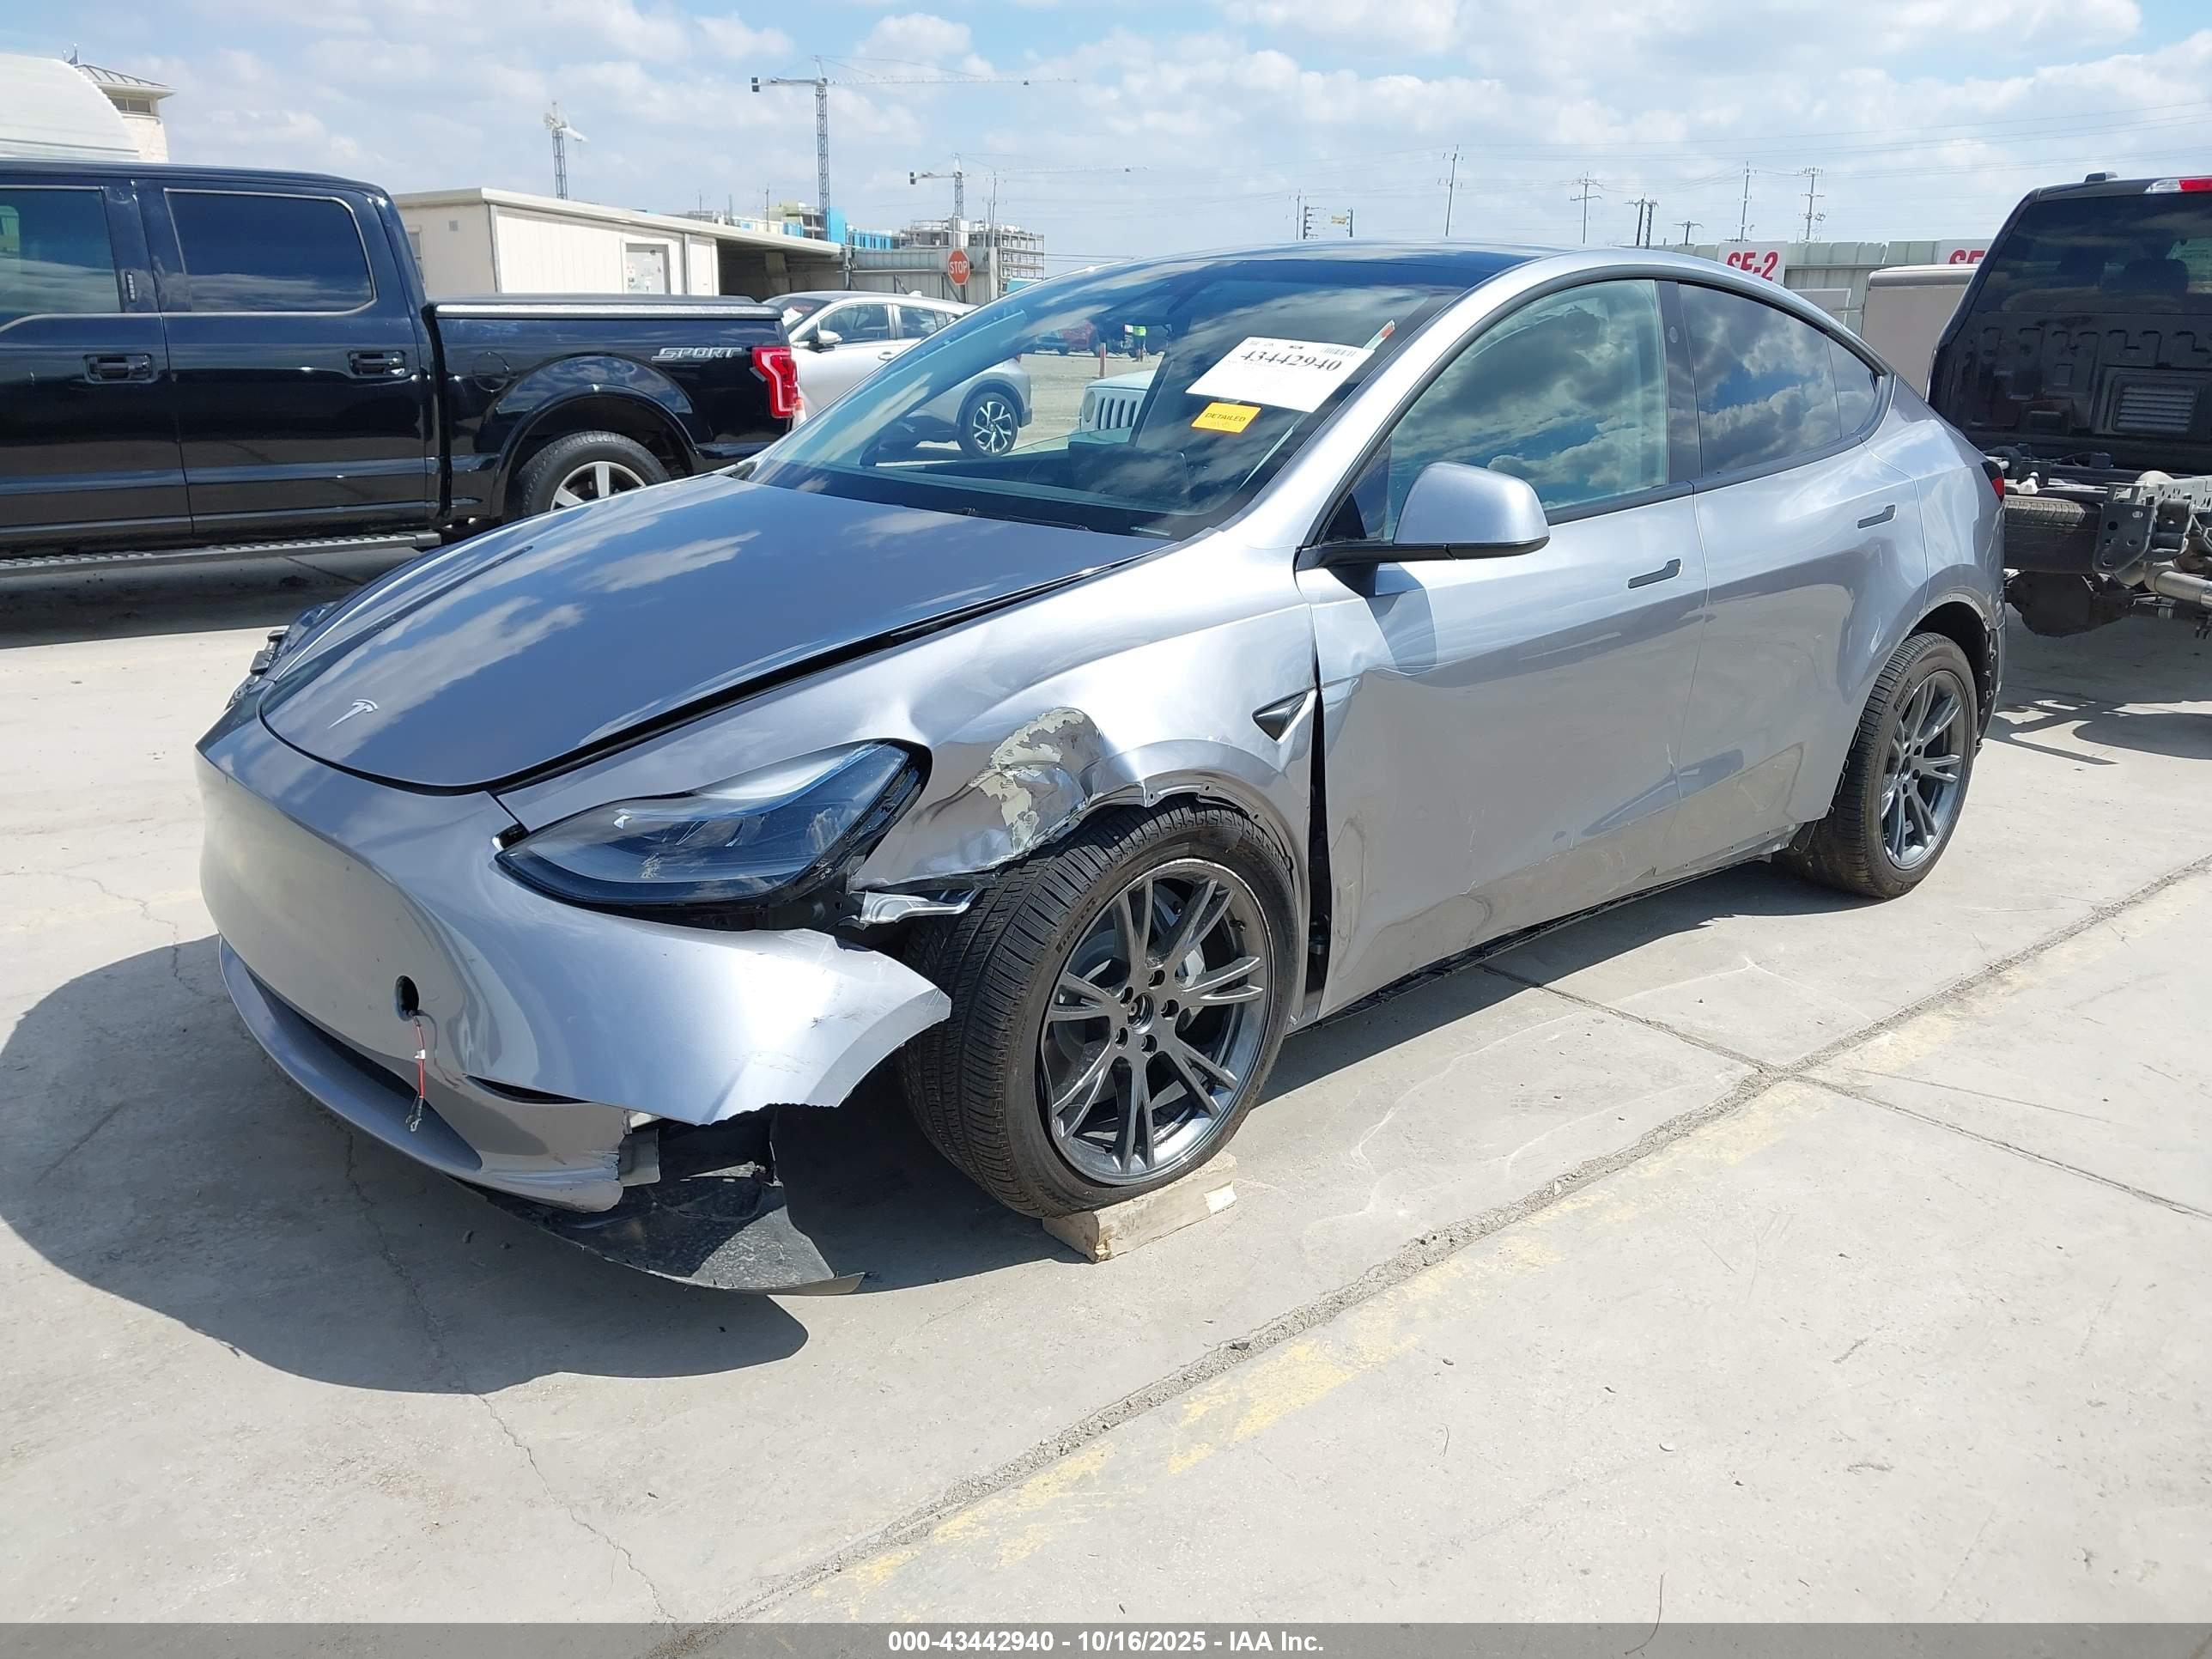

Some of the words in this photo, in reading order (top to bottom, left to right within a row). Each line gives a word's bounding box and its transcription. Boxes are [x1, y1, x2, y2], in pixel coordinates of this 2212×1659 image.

[950, 260, 968, 275] STOP
[651, 347, 742, 361] SPORT
[1241, 350, 1342, 372] 43442940
[1205, 412, 1246, 422] DETAILED
